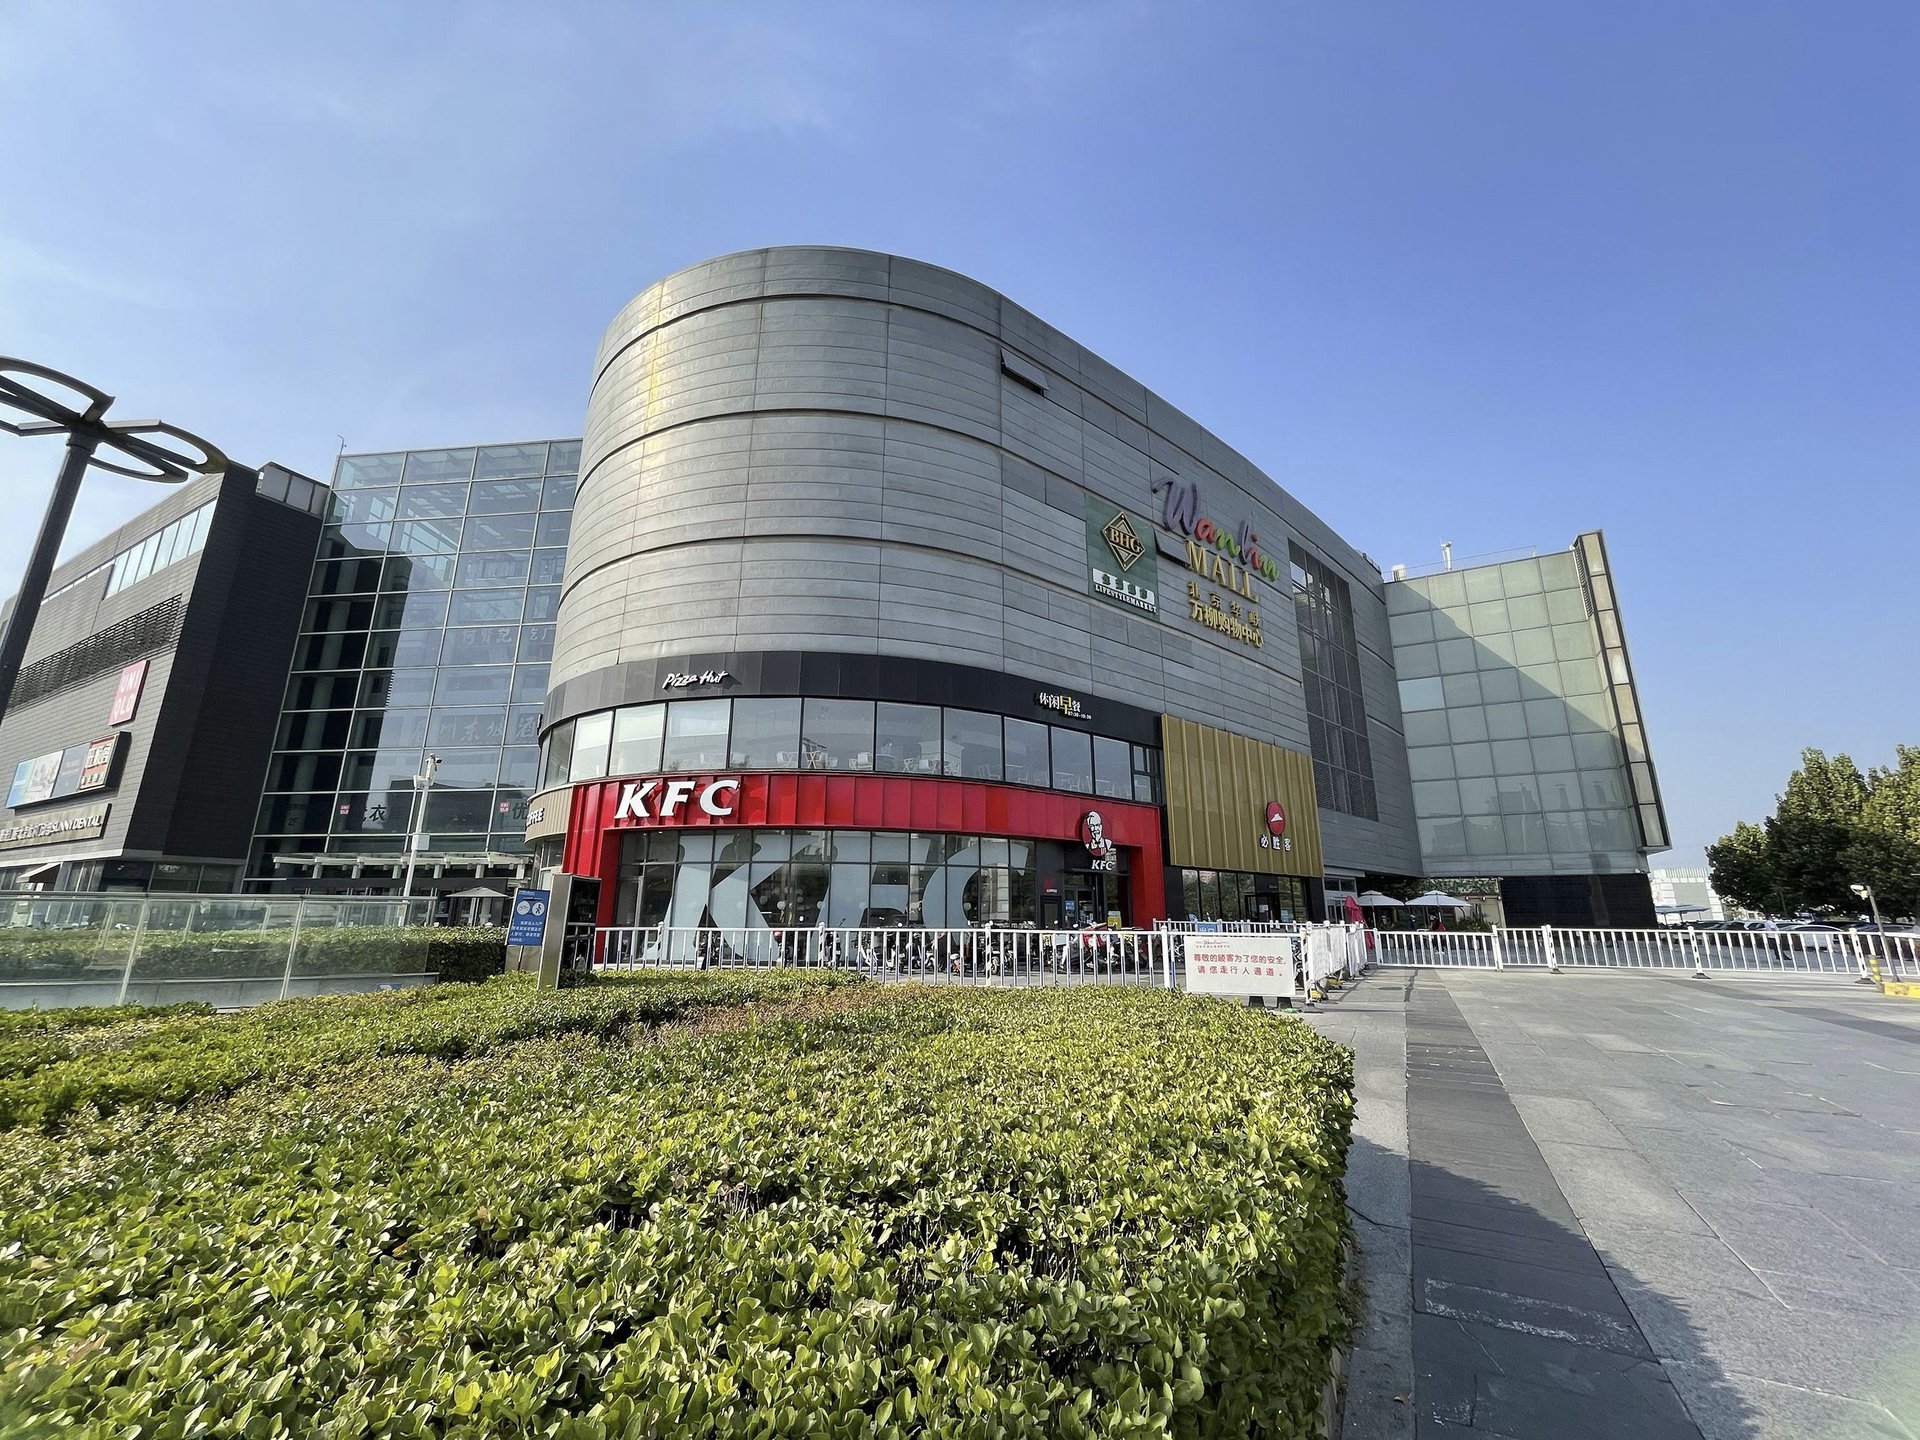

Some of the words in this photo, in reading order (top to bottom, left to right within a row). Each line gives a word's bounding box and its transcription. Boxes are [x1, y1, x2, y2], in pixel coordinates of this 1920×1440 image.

[1110, 529, 1141, 552] BHG
[1186, 540, 1258, 603] MALL
[1188, 599, 1264, 648] 万柳购物中心
[119, 671, 141, 693] UNI
[662, 673, 697, 689] Pizza
[699, 670, 729, 685] Hut
[111, 694, 136, 720] QLO
[1039, 692, 1081, 714] 休闲早餐
[614, 780, 740, 819] KFC
[72, 815, 101, 830] DENTAL
[1261, 834, 1291, 851] 必胜客
[1091, 860, 1113, 870] KFC
